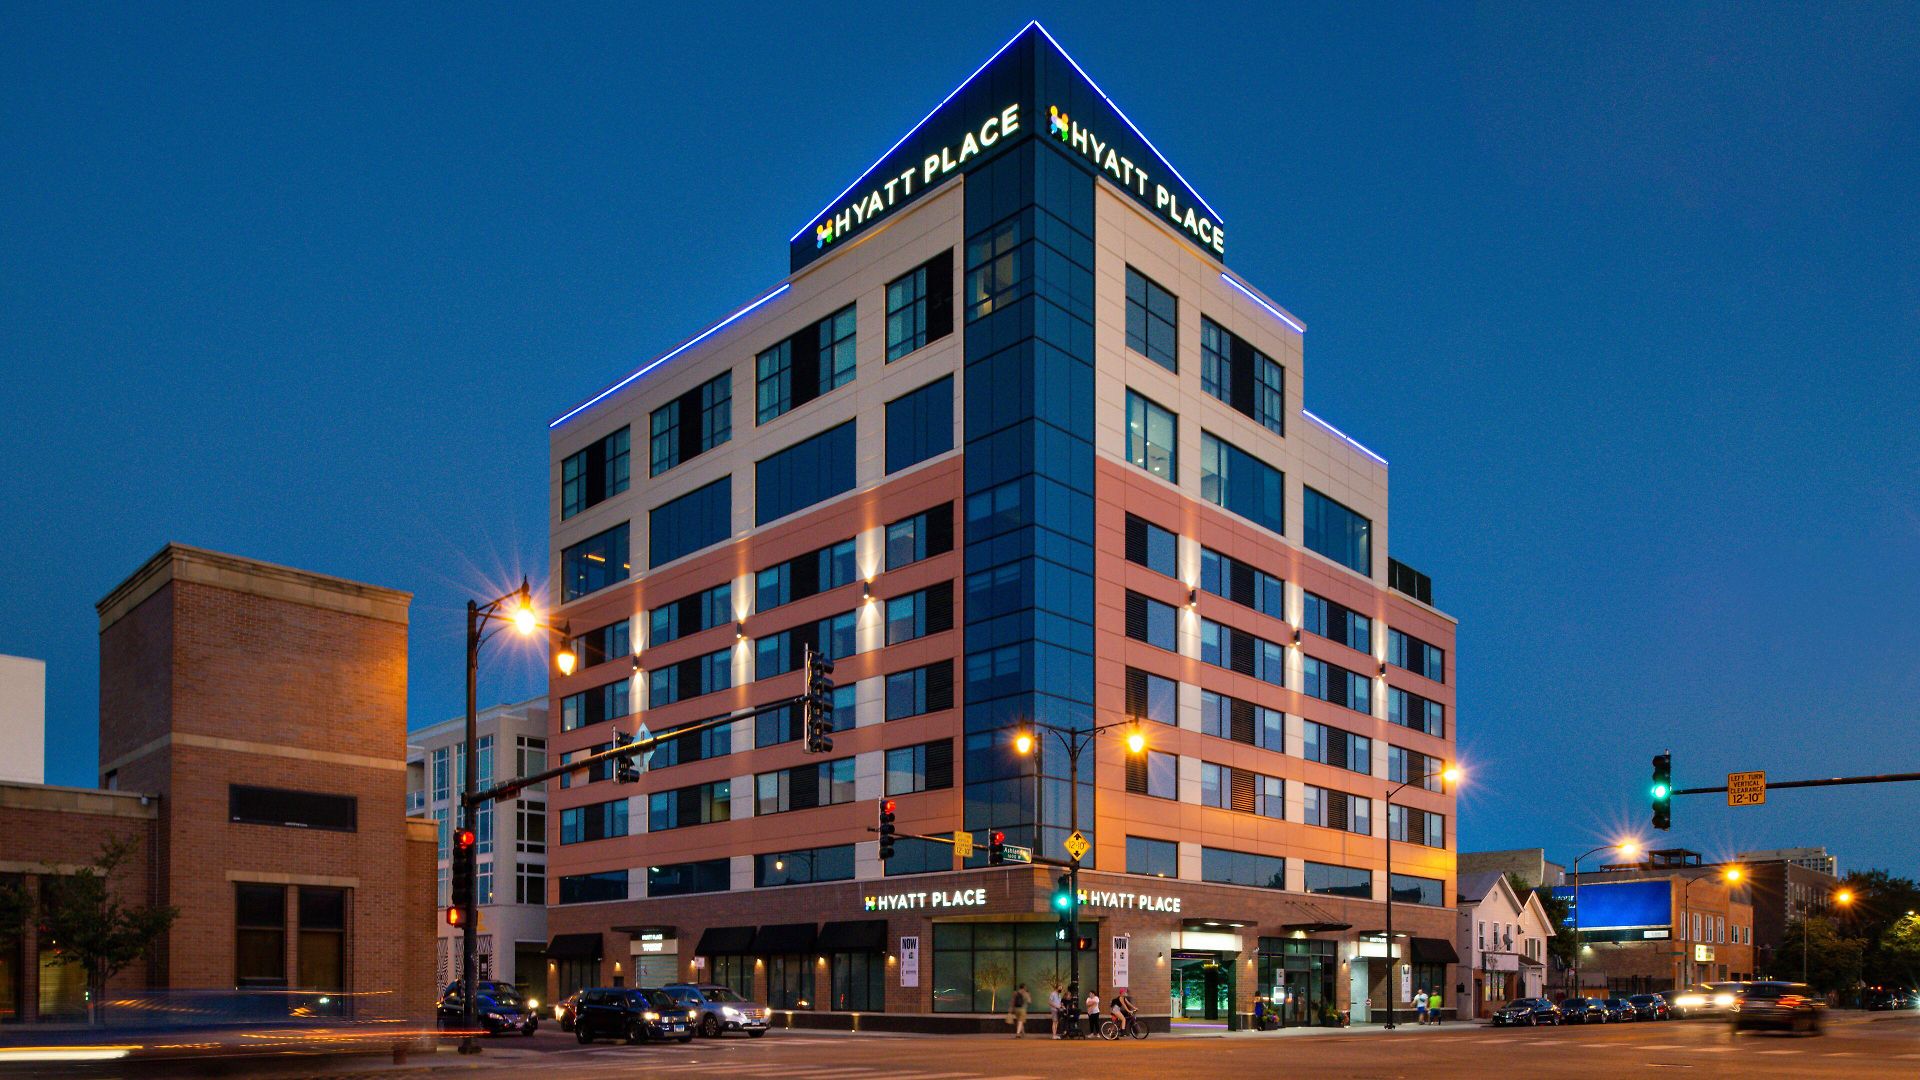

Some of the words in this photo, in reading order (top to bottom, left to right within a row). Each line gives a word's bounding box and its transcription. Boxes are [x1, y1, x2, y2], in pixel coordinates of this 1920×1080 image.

[835, 167, 916, 238] HYATT
[924, 103, 1020, 184] PLACE
[1072, 121, 1149, 196] HYATT
[1156, 184, 1224, 254] PLACE
[1730, 785, 1764, 794] CLEARANCE
[878, 892, 927, 911] HYATT
[932, 888, 986, 908] PLACE
[1091, 890, 1135, 909] HYATT
[1139, 893, 1181, 913] PLACE
[902, 938, 917, 950] NOW
